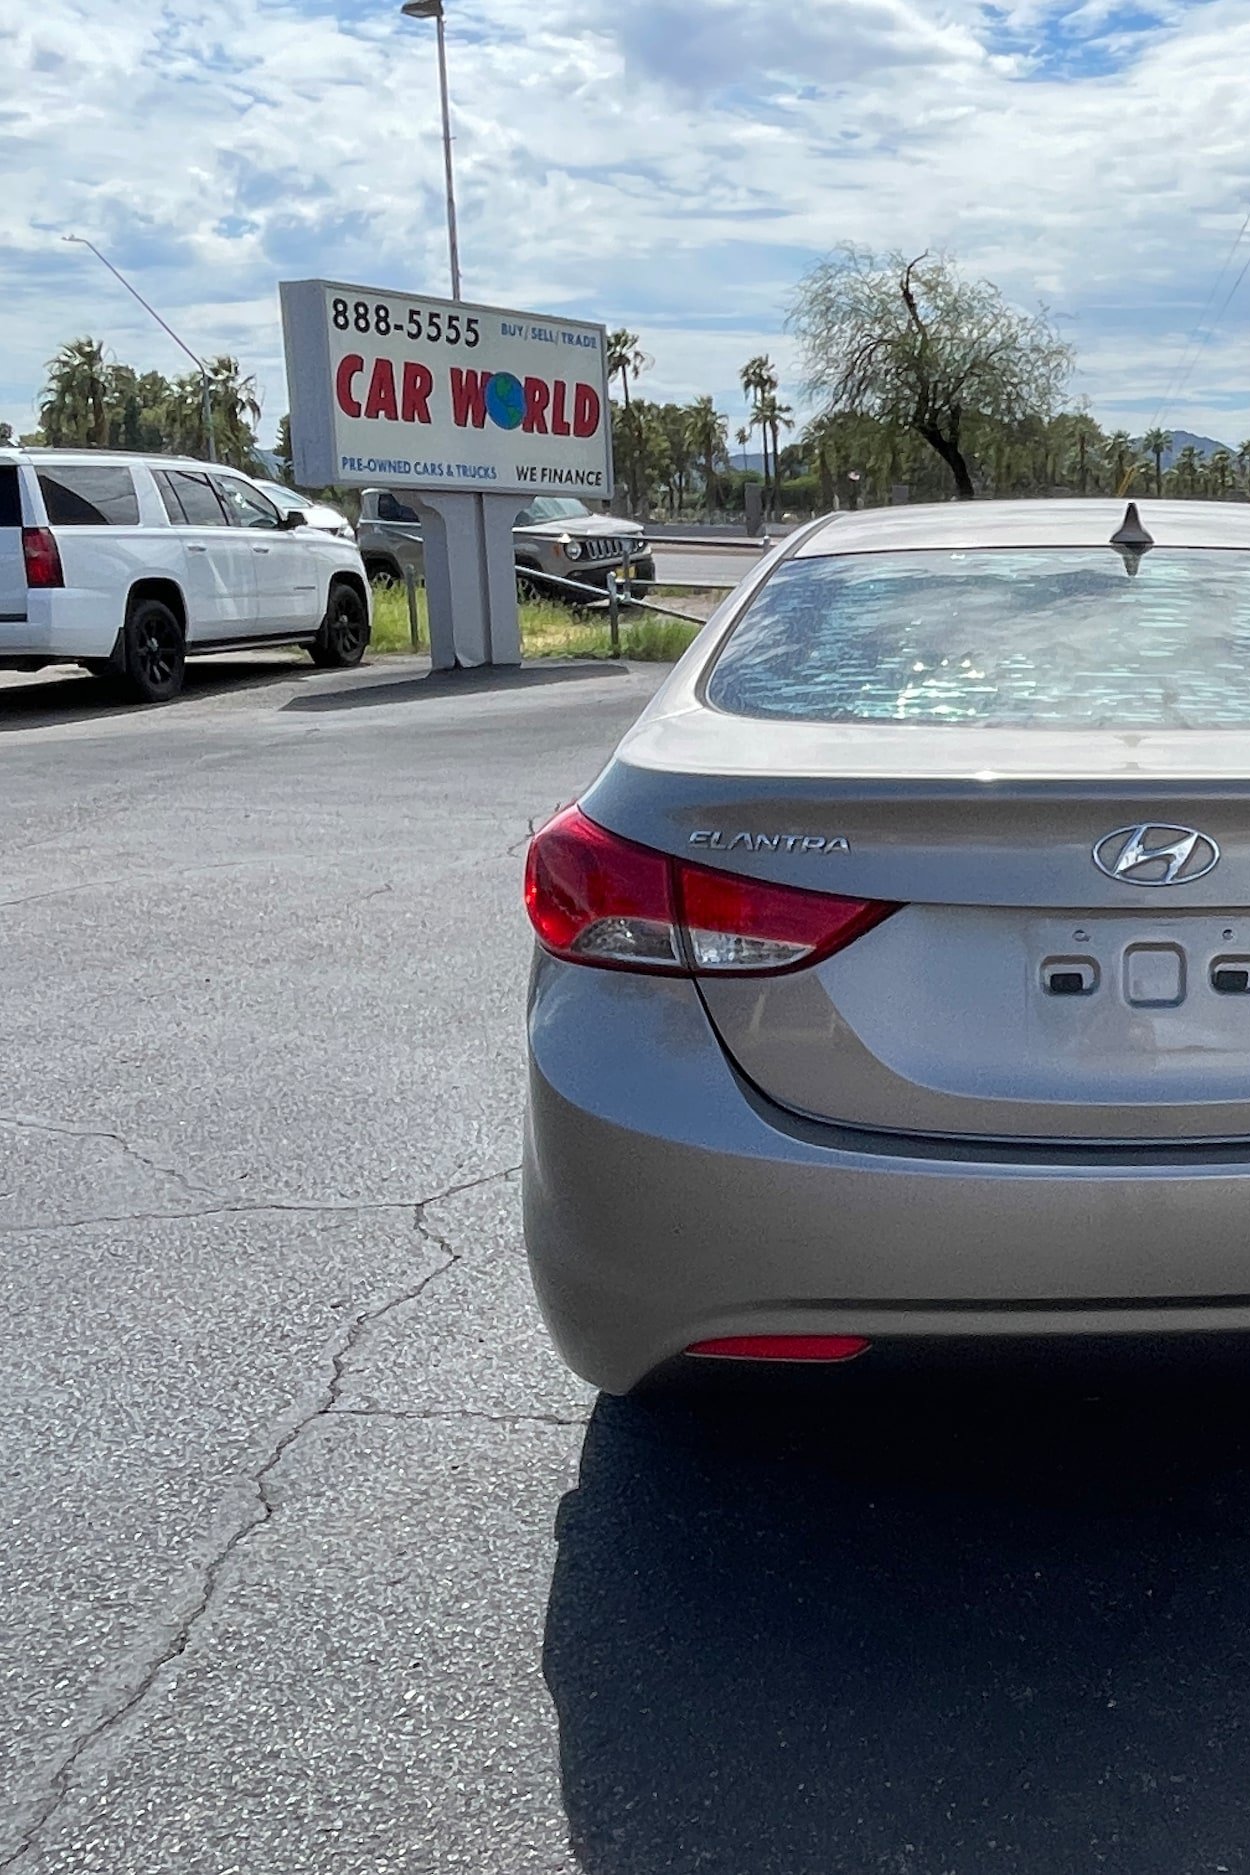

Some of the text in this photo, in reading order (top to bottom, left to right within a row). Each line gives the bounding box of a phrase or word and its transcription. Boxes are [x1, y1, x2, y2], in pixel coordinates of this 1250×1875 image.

[332, 298, 480, 348] 888-5555
[336, 353, 600, 438] CAR WORLD
[341, 456, 497, 480] PRE-OWNED CARS & TRUCKS
[515, 465, 602, 486] WE FINANCE
[688, 829, 851, 855] ELANTRA
